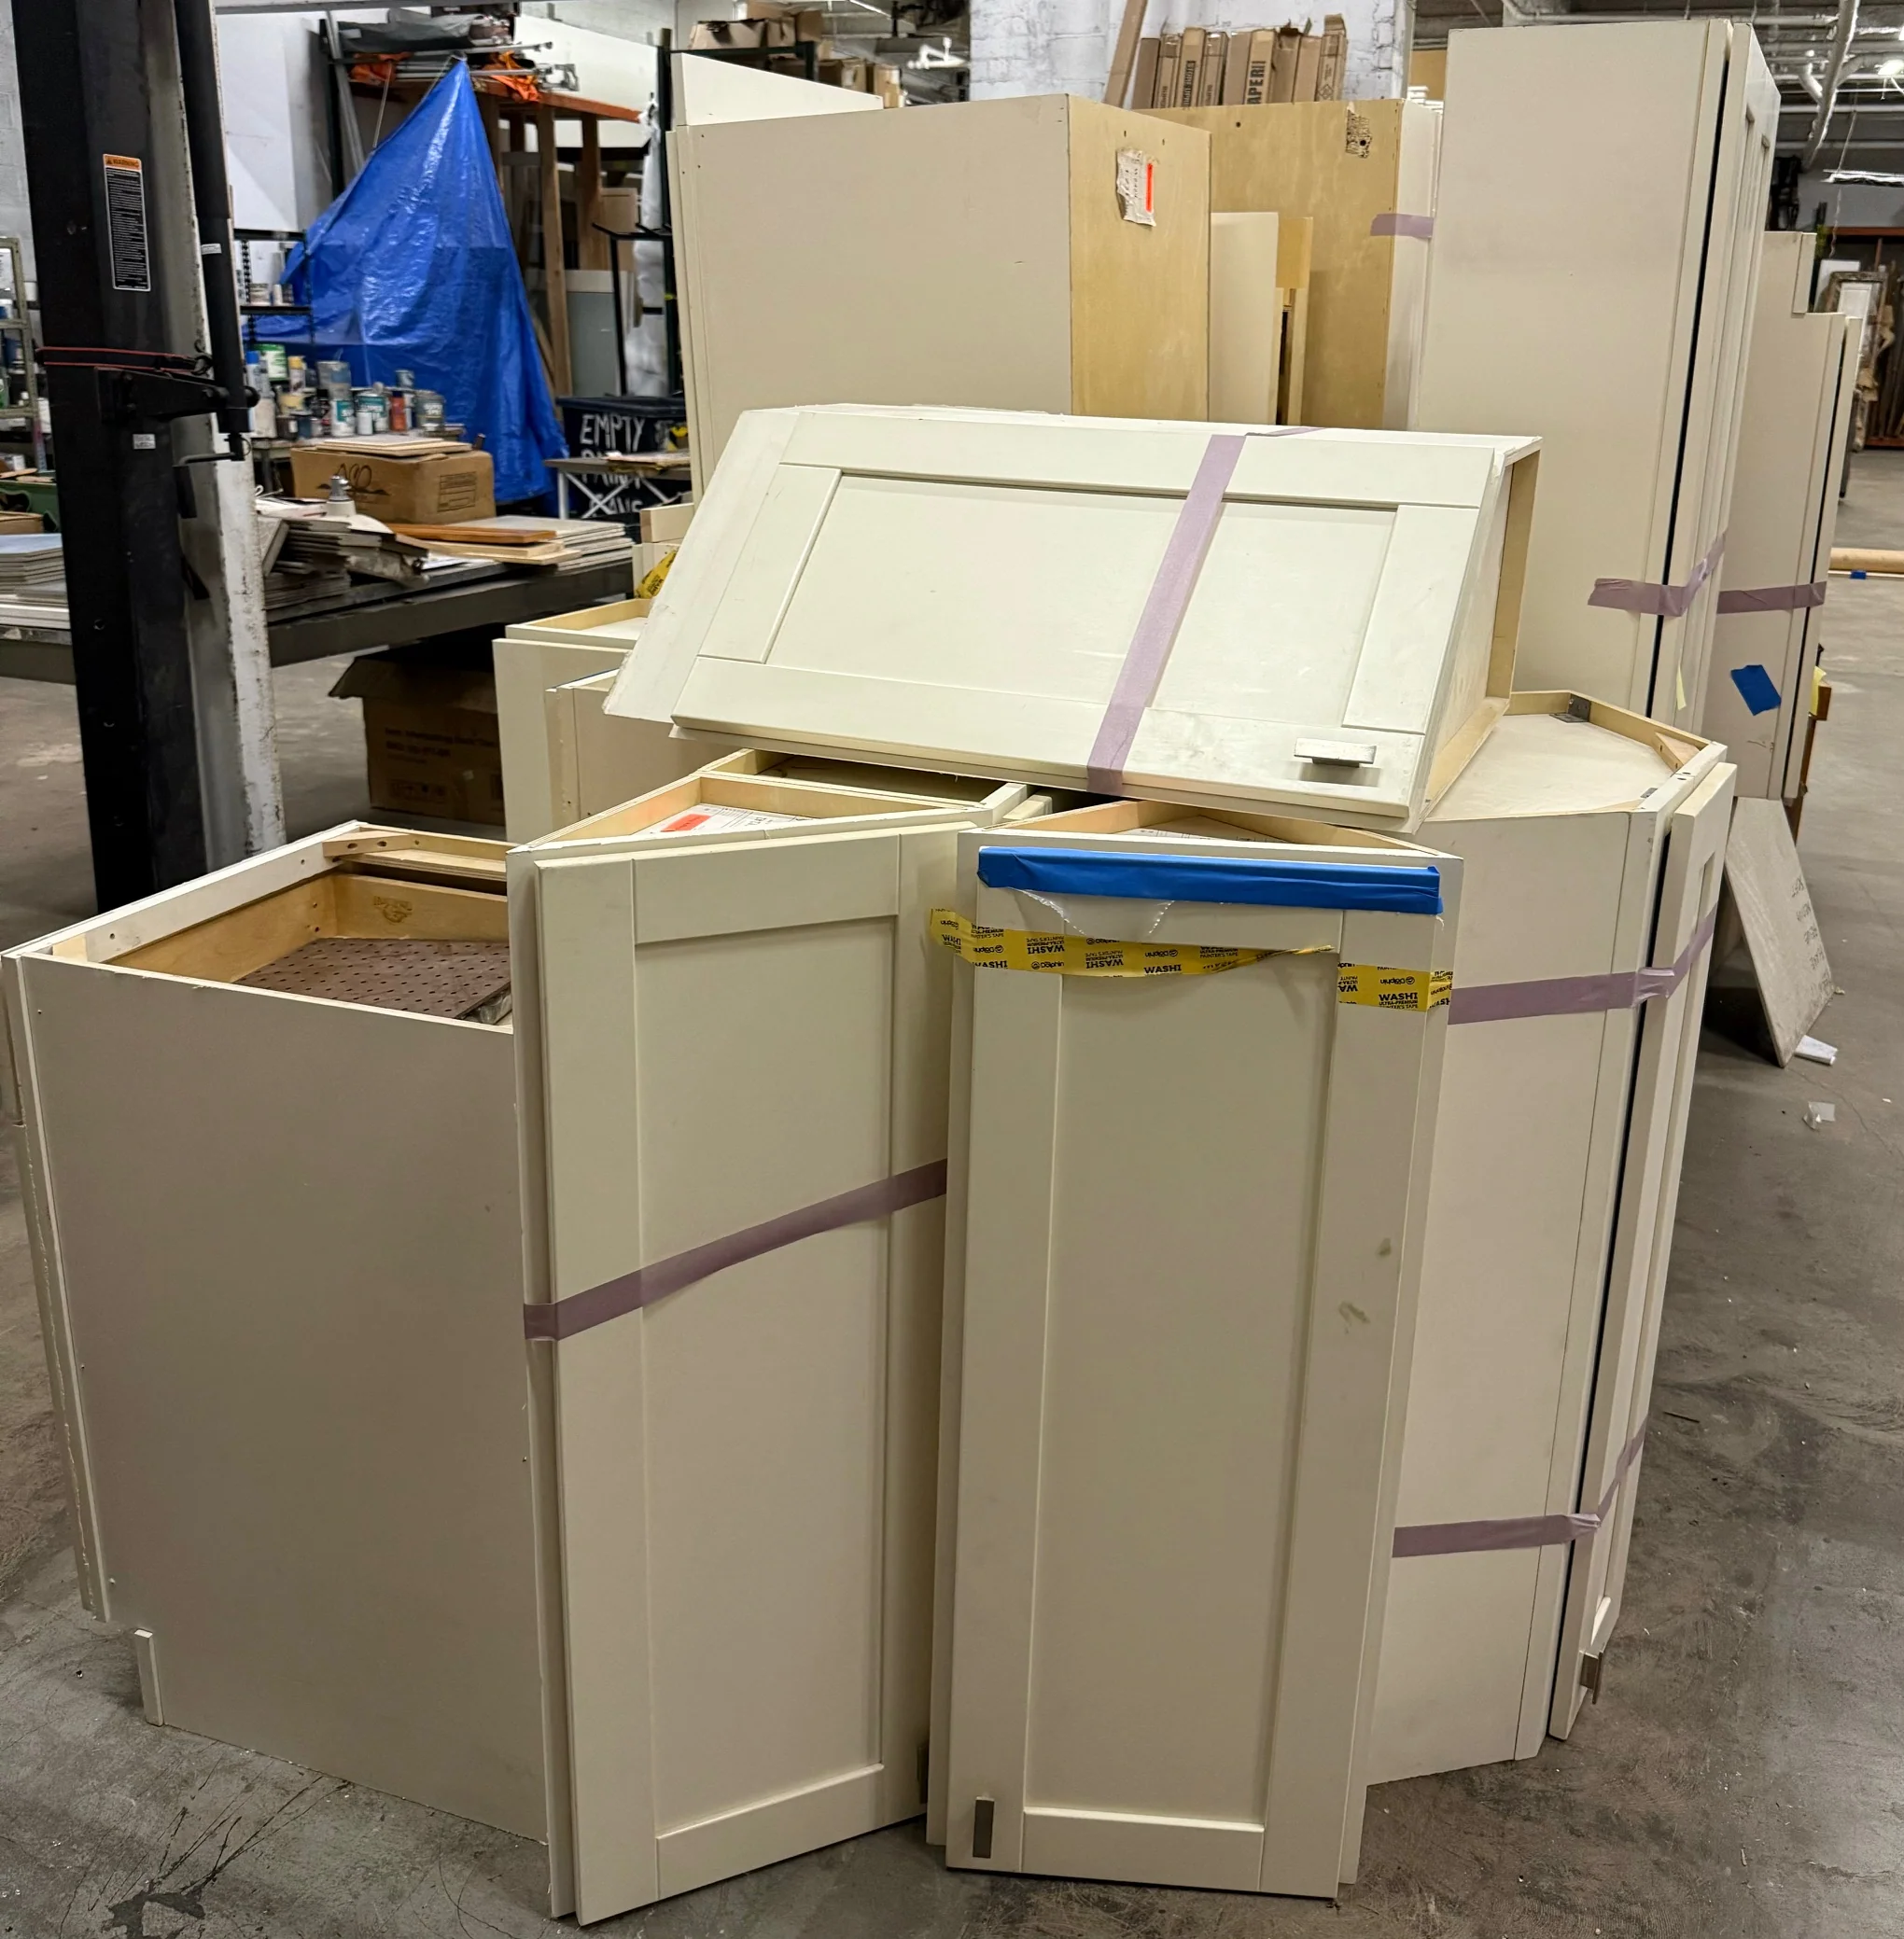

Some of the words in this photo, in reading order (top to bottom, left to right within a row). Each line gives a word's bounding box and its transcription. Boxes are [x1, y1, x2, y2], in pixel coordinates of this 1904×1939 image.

[580, 413, 645, 452] EMPTY
[1027, 944, 1065, 955] WASHI
[1085, 958, 1124, 970] WASHI
[1144, 964, 1182, 974] WASHI
[1379, 992, 1418, 1001] WASHI
